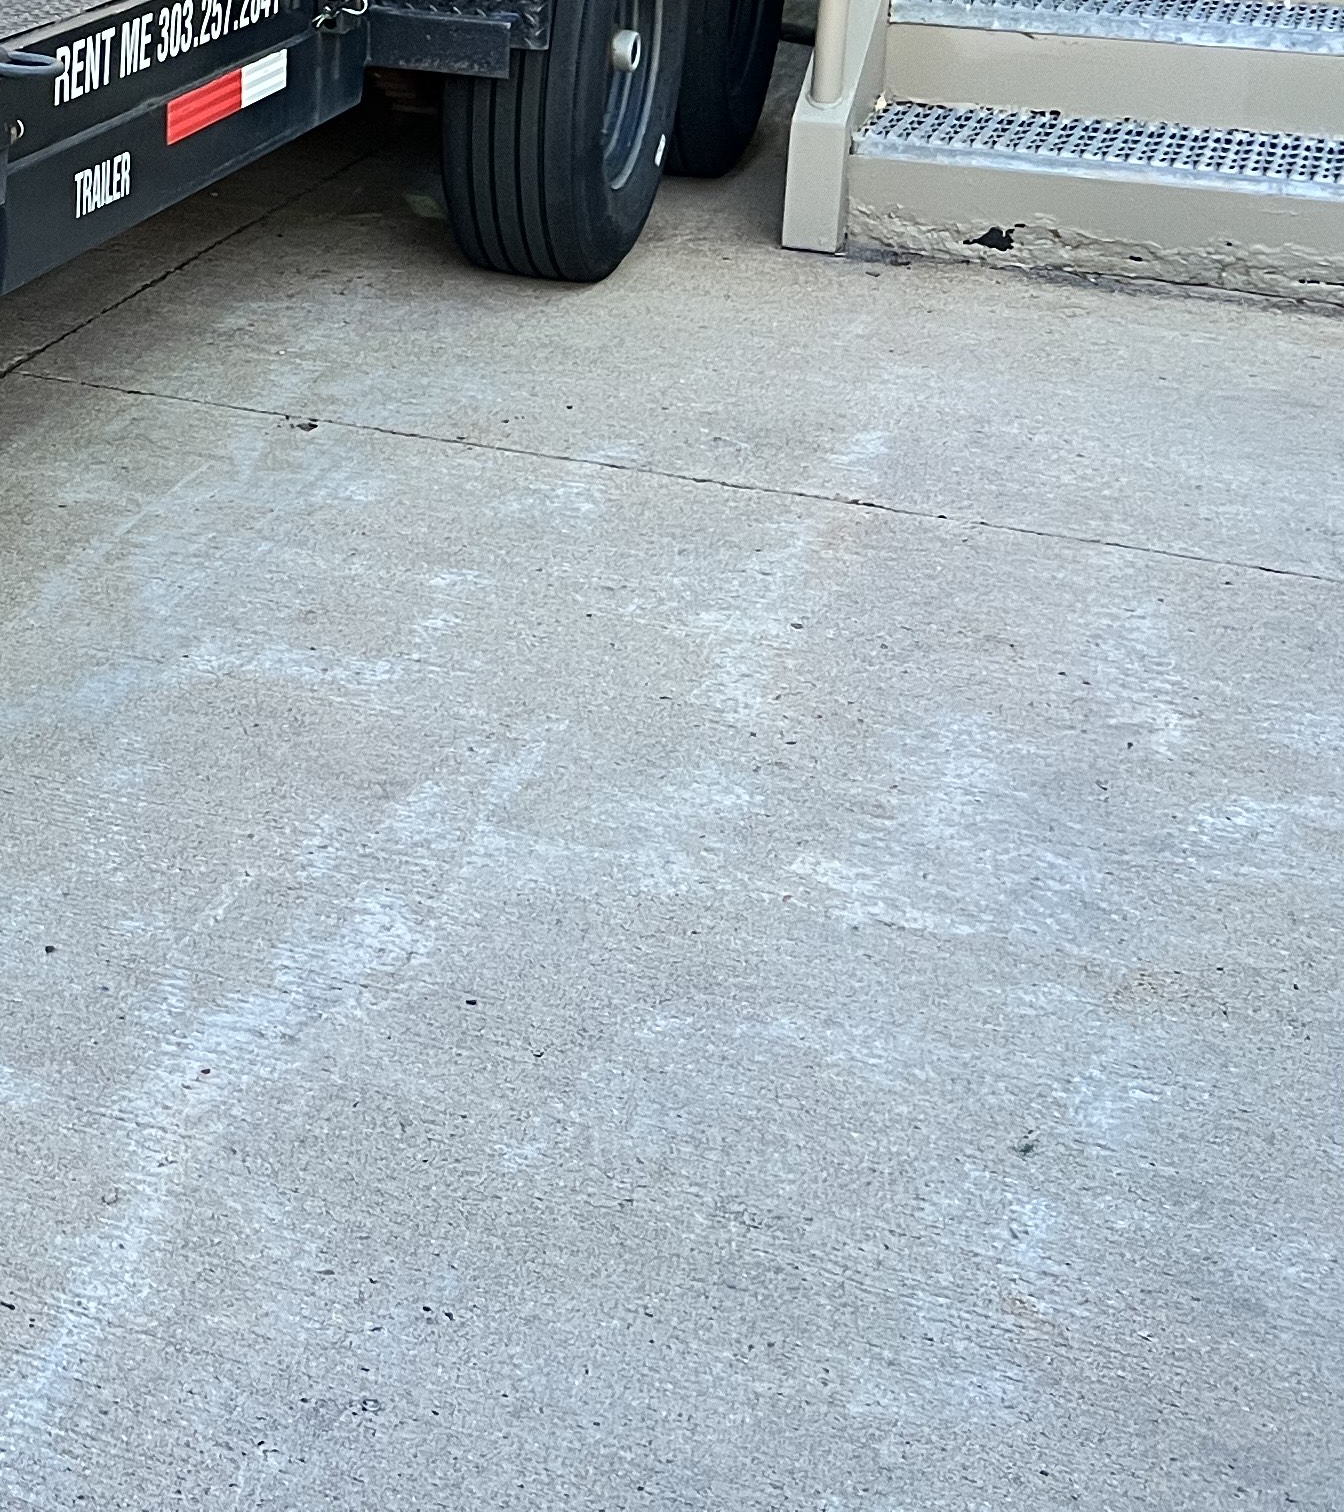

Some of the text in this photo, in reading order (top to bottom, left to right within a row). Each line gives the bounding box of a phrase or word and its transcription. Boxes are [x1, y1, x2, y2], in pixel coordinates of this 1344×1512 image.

[54, 26, 116, 107] RENT
[119, 12, 154, 79] ME
[74, 151, 131, 219] TRAILER
